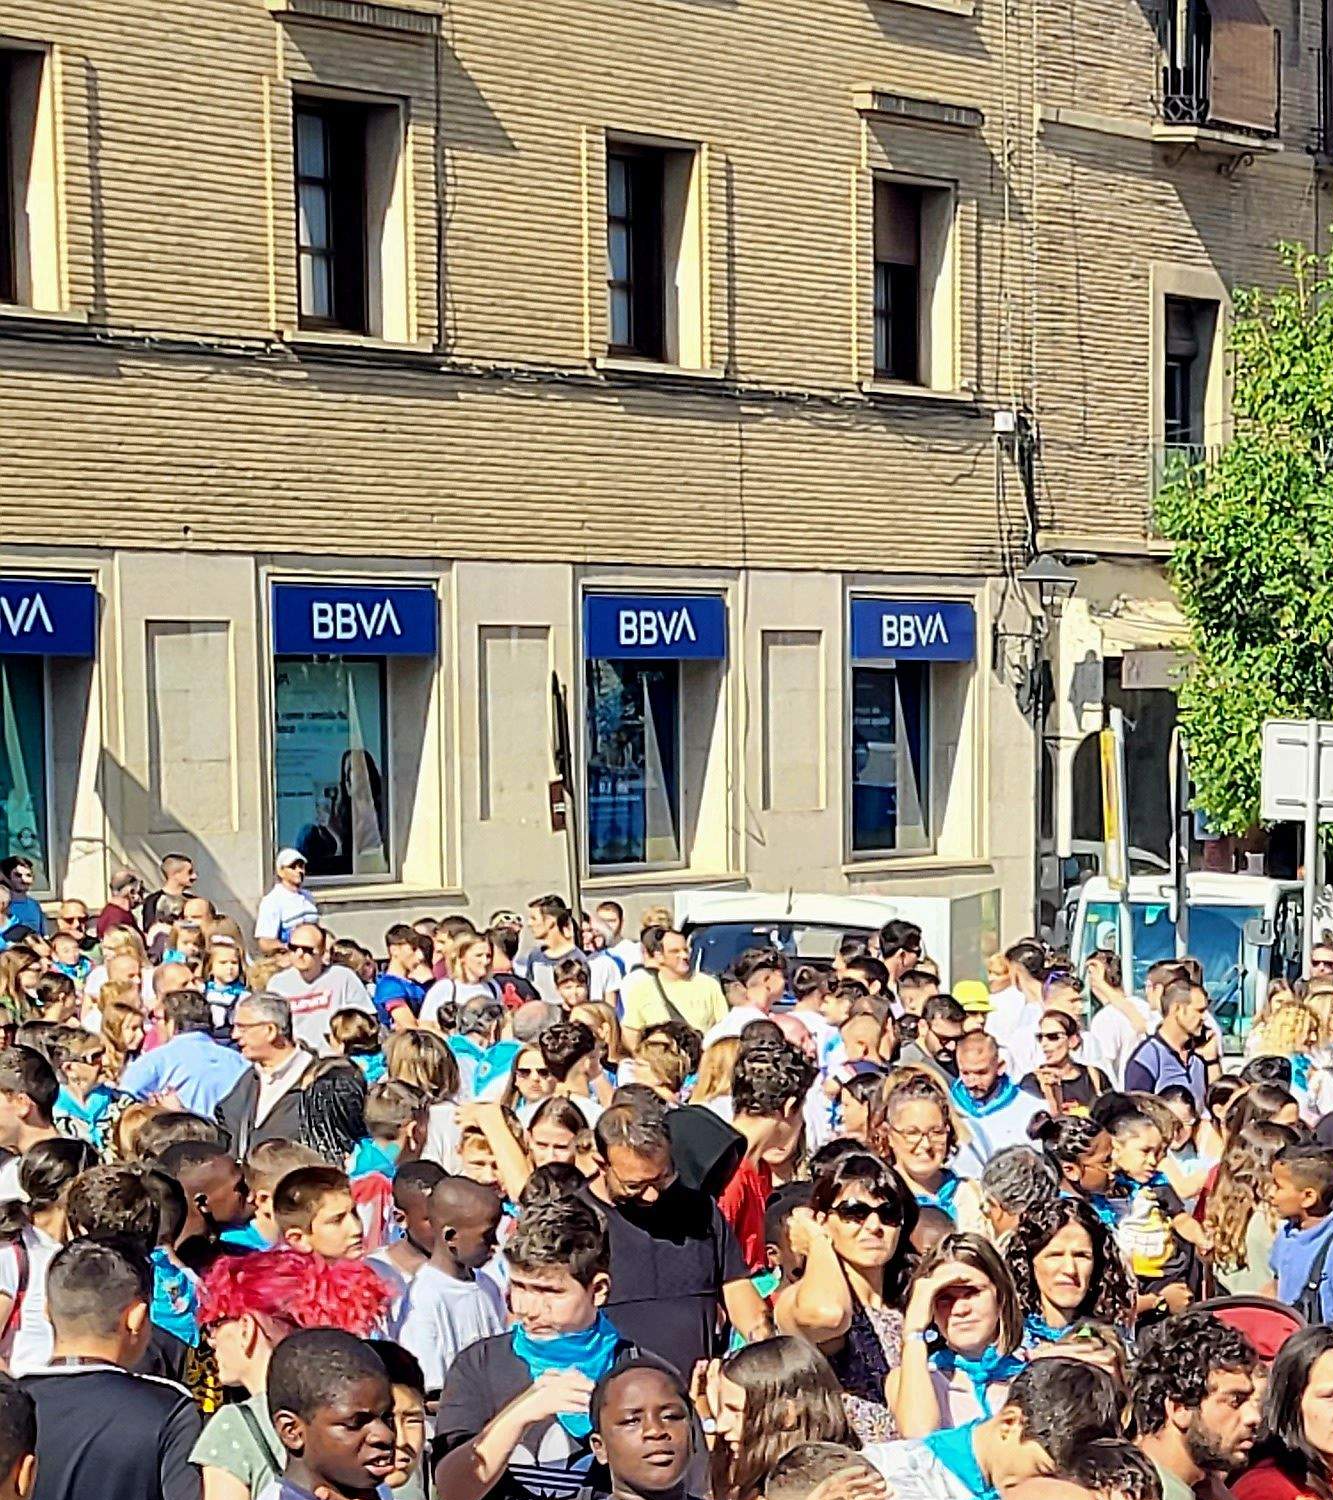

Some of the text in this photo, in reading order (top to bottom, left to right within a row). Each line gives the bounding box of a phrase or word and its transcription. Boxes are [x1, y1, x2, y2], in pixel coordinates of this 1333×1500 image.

[0, 592, 53, 636] VA
[312, 599, 401, 640] BBVA
[619, 607, 696, 645] BBVA
[882, 612, 949, 647] BBVA
